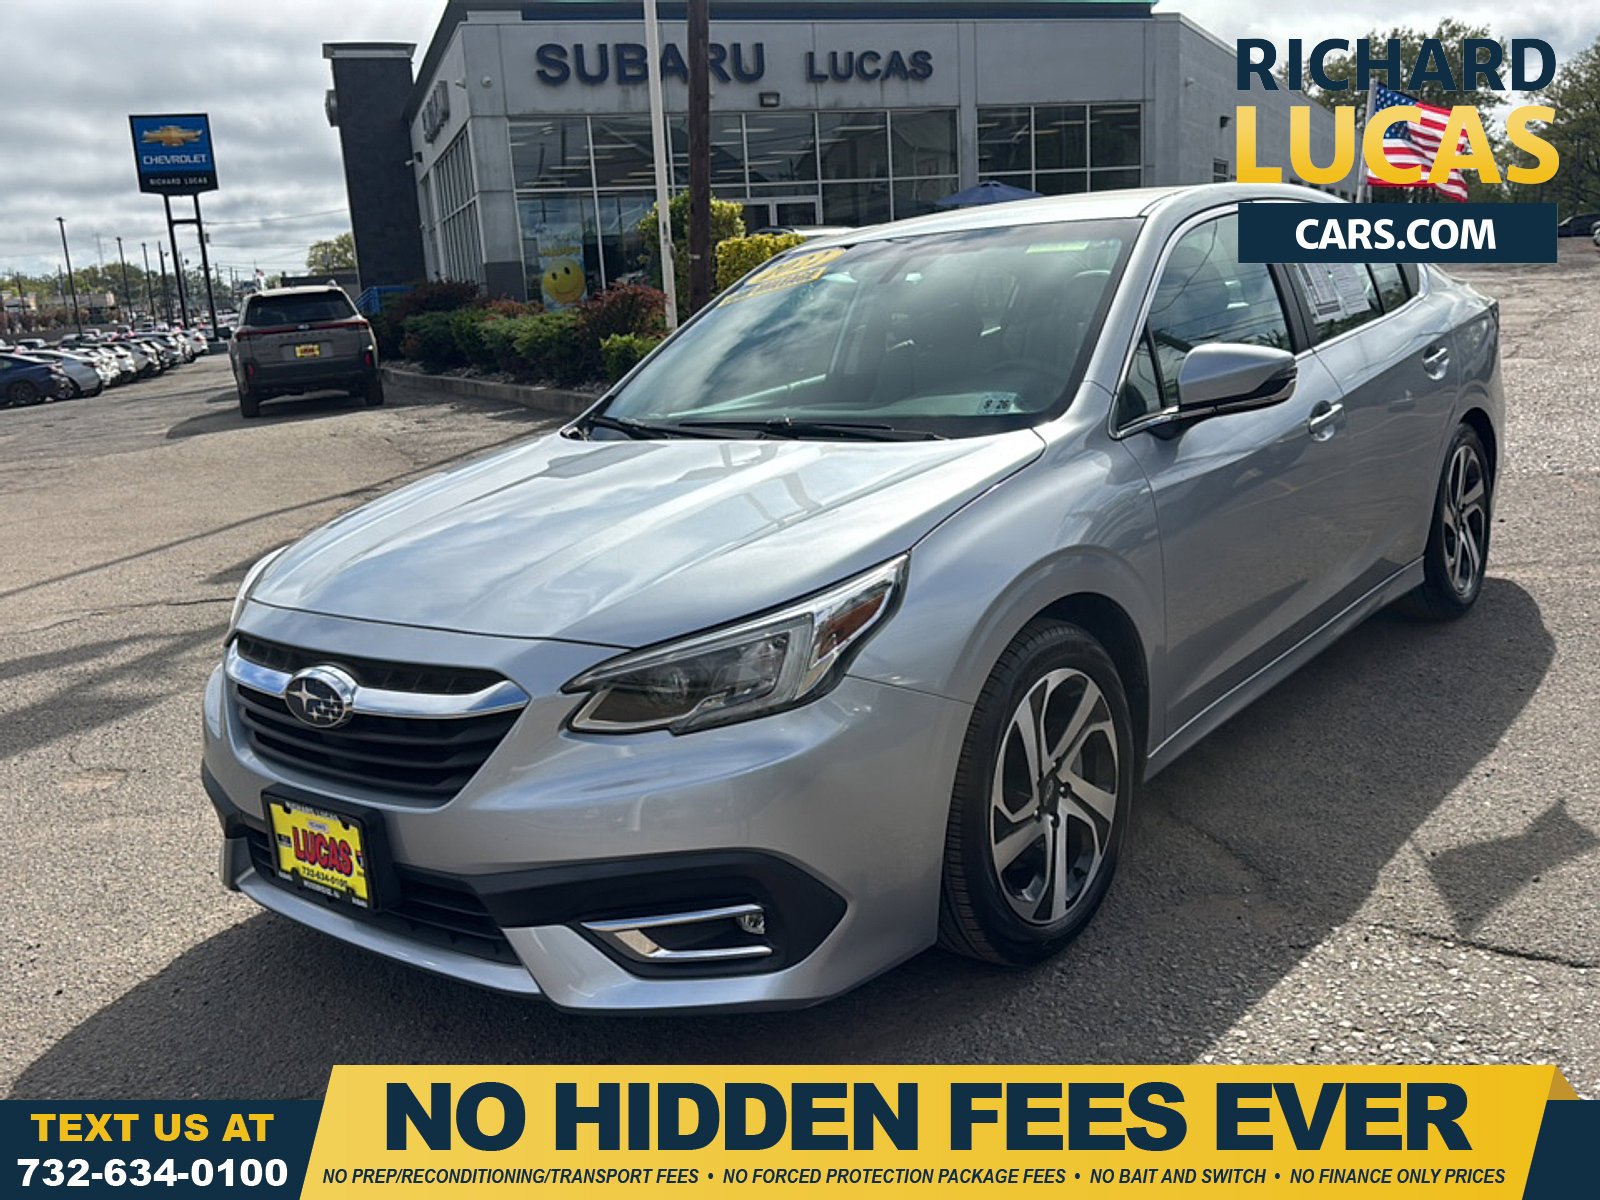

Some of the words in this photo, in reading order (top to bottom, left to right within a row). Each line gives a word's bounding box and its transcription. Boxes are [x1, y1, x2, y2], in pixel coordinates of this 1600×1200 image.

[536, 43, 765, 86] SUBARU
[806, 50, 932, 81] LUCAS
[143, 154, 206, 165] CHEVROLET
[291, 826, 354, 877] LUCAS
